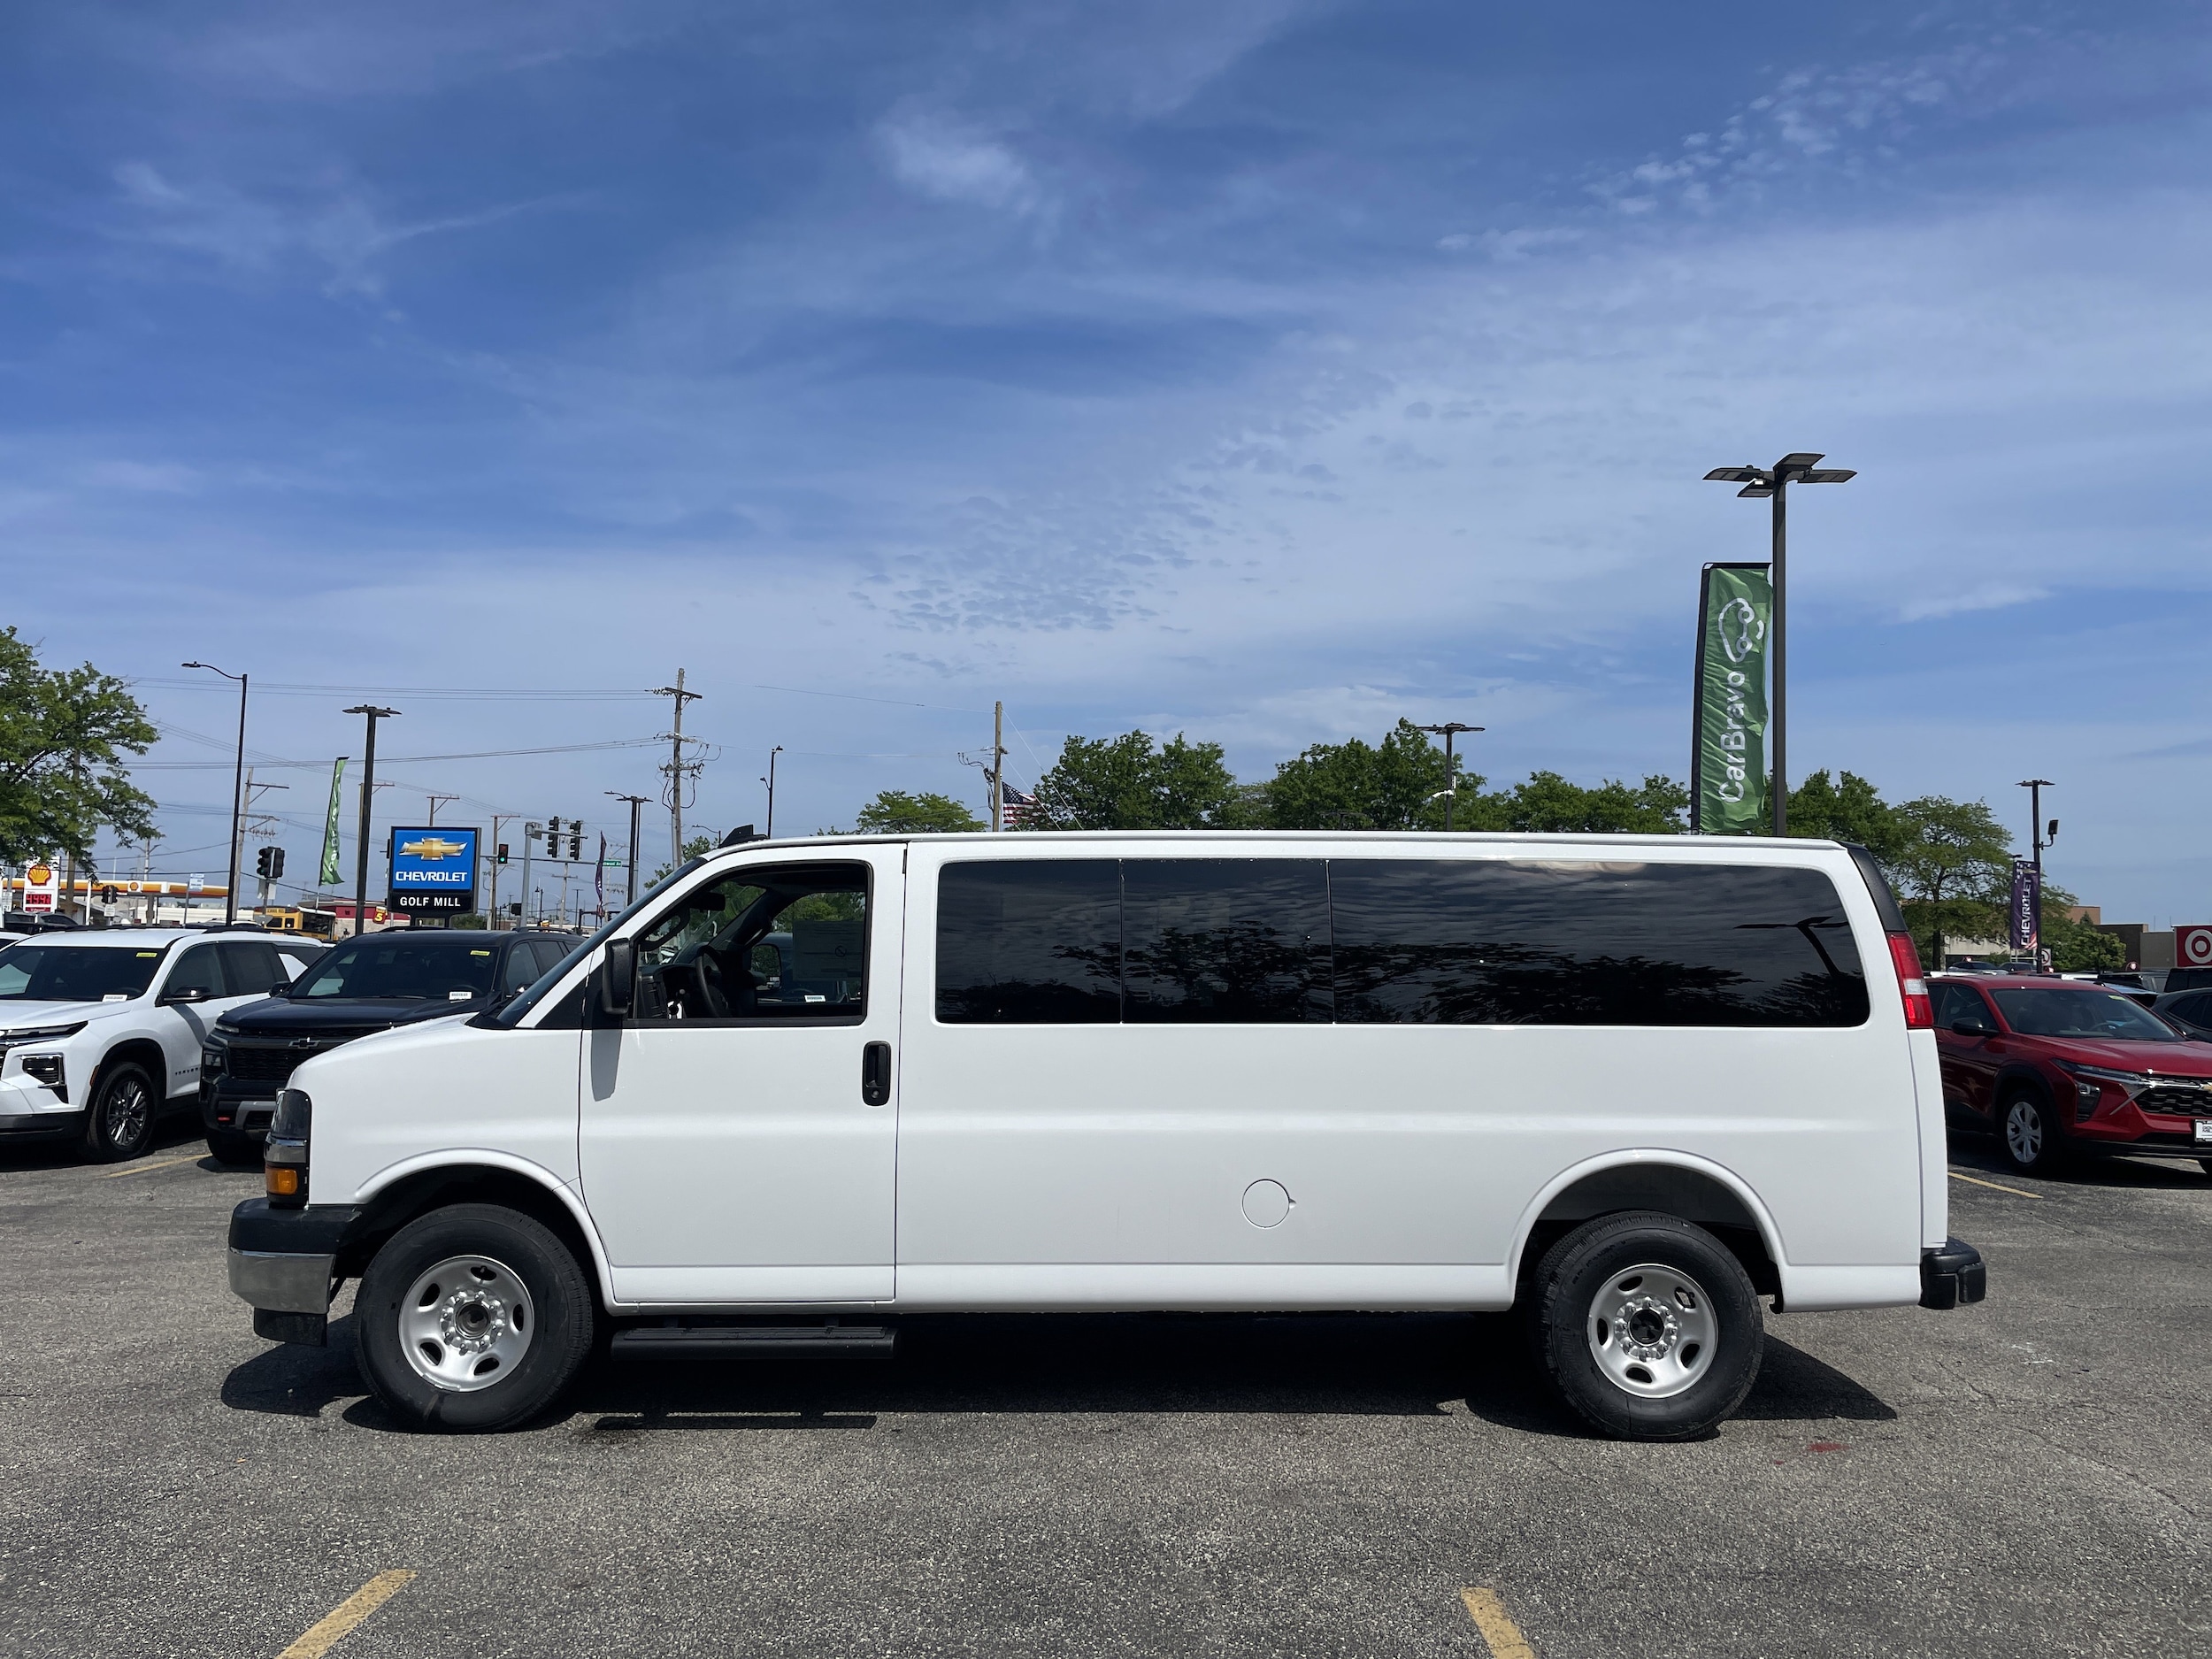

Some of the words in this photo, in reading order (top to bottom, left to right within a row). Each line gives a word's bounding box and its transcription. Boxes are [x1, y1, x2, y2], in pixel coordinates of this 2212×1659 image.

[1718, 670, 1746, 803] CarBravo
[396, 871, 467, 882] CHEVROLET
[400, 896, 429, 907] GOLF
[434, 897, 461, 907] MILL
[2021, 877, 2032, 946] CHEVROLET
